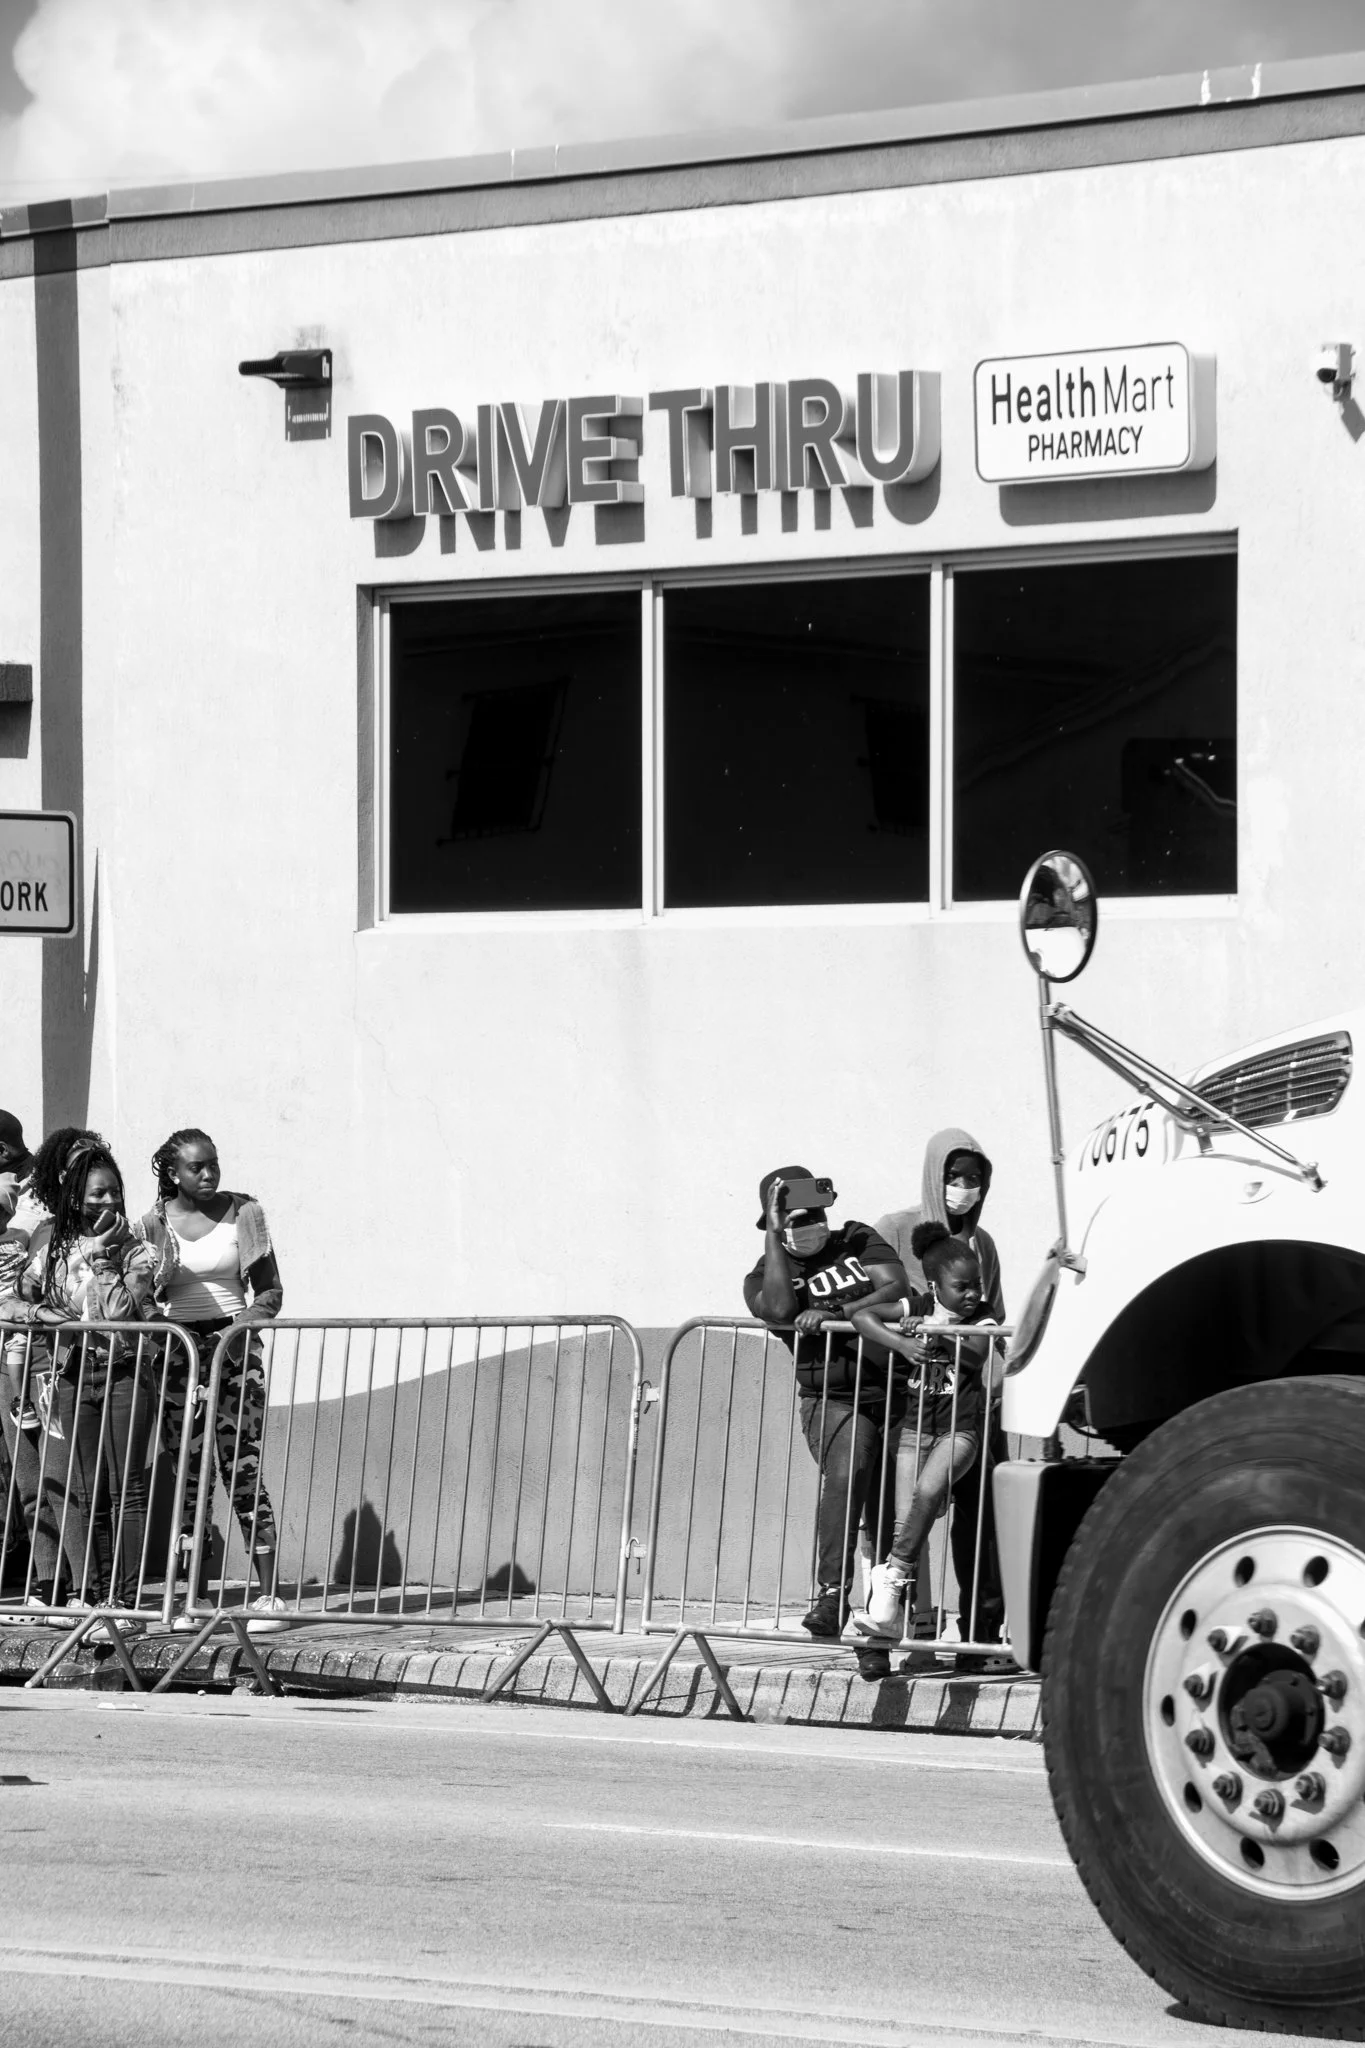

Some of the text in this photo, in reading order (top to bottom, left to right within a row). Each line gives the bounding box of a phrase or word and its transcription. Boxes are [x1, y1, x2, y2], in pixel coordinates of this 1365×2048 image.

[347, 370, 916, 519] DRIVE THRU
[1029, 425, 1143, 462] PHARMACY
